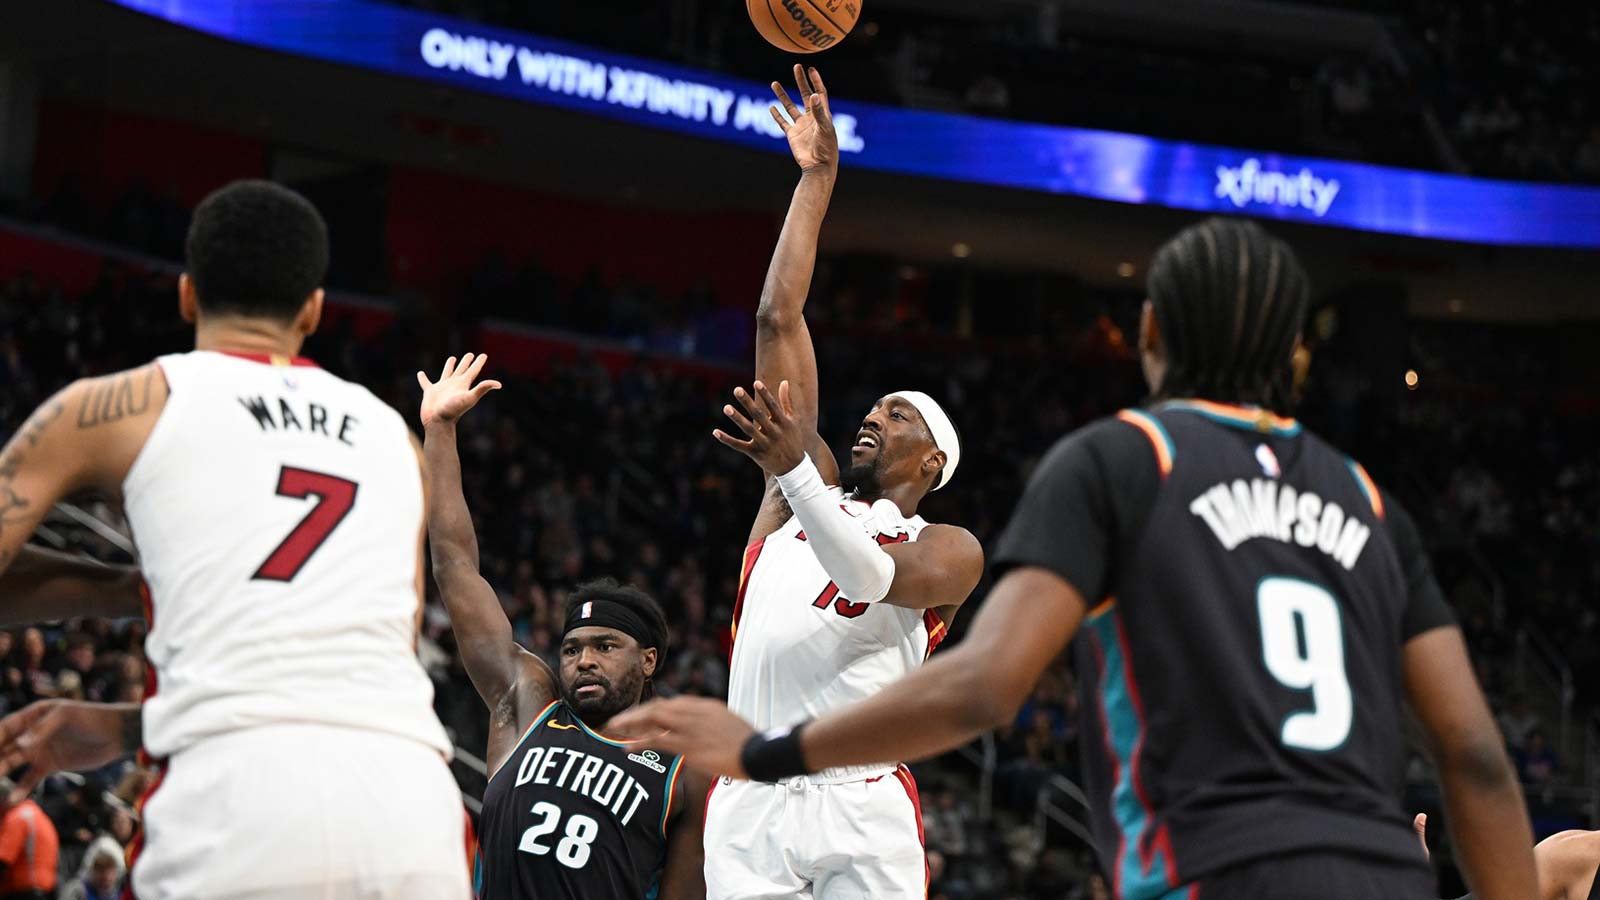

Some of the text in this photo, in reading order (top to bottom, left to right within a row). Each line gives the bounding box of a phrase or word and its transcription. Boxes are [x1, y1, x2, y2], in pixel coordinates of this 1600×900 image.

[782, 0, 836, 48] Wilson
[420, 27, 515, 79] ONLY
[516, 50, 607, 99] WITH
[606, 66, 738, 125] XFINITY
[1214, 158, 1340, 217] xfinity
[237, 395, 361, 447] WARE
[249, 464, 359, 583] 7
[1190, 477, 1371, 570] THOMPSON
[1256, 575, 1353, 753] 9
[514, 746, 650, 827] DETROIT
[517, 800, 599, 870] 28
